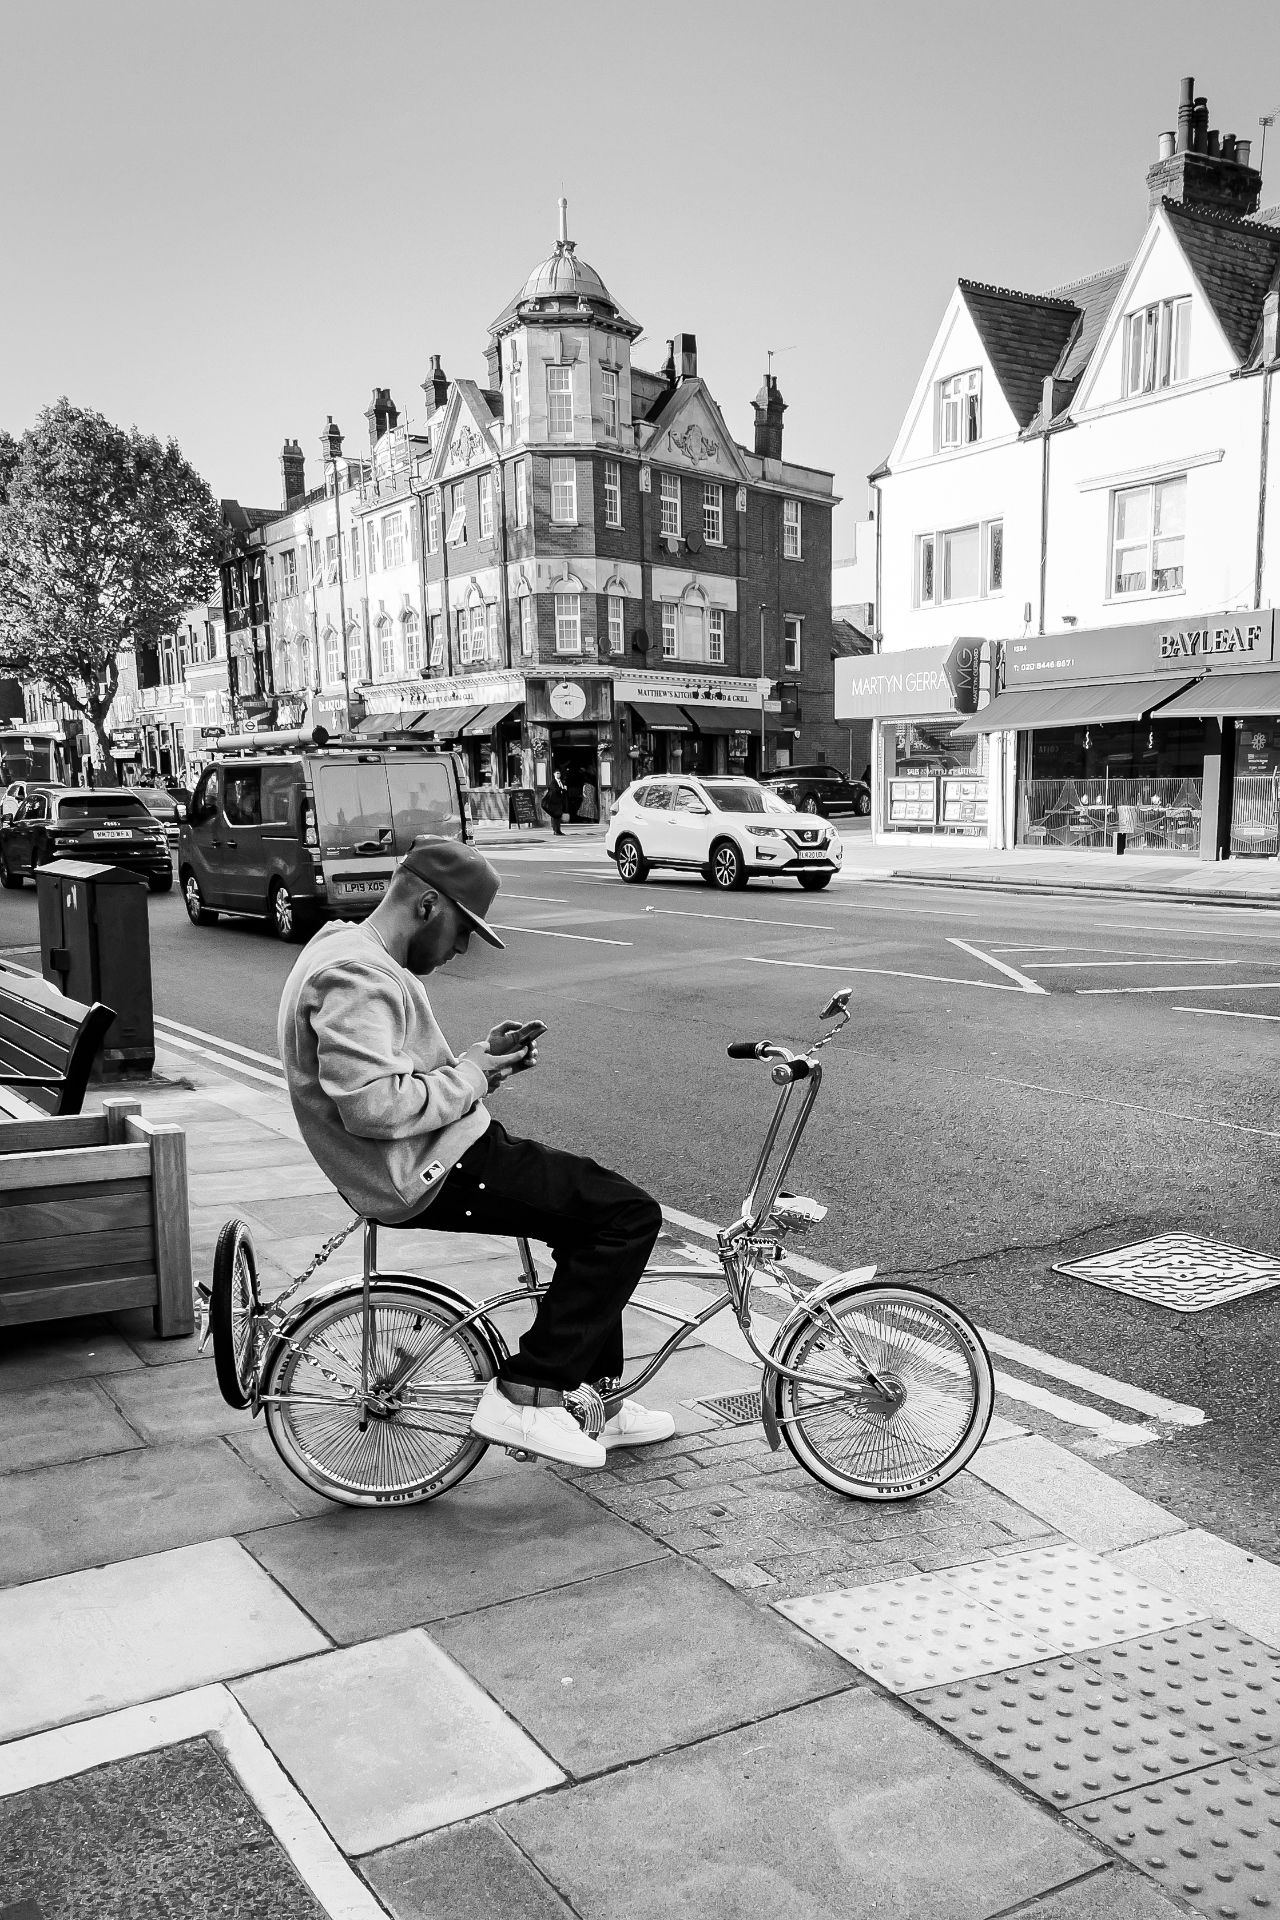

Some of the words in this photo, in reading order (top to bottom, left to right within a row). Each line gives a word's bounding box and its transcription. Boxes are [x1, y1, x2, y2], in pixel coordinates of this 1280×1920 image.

[1159, 625, 1261, 658] BAYLEAF
[956, 648, 973, 689] MG
[852, 674, 902, 696] MARTYN
[905, 671, 951, 692] GERRA
[637, 688, 673, 698] MATTHEW'S
[674, 691, 699, 699] KITCH
[345, 884, 365, 892] LP19
[368, 882, 385, 891] XOS
[877, 1483, 913, 1494] RIDER
